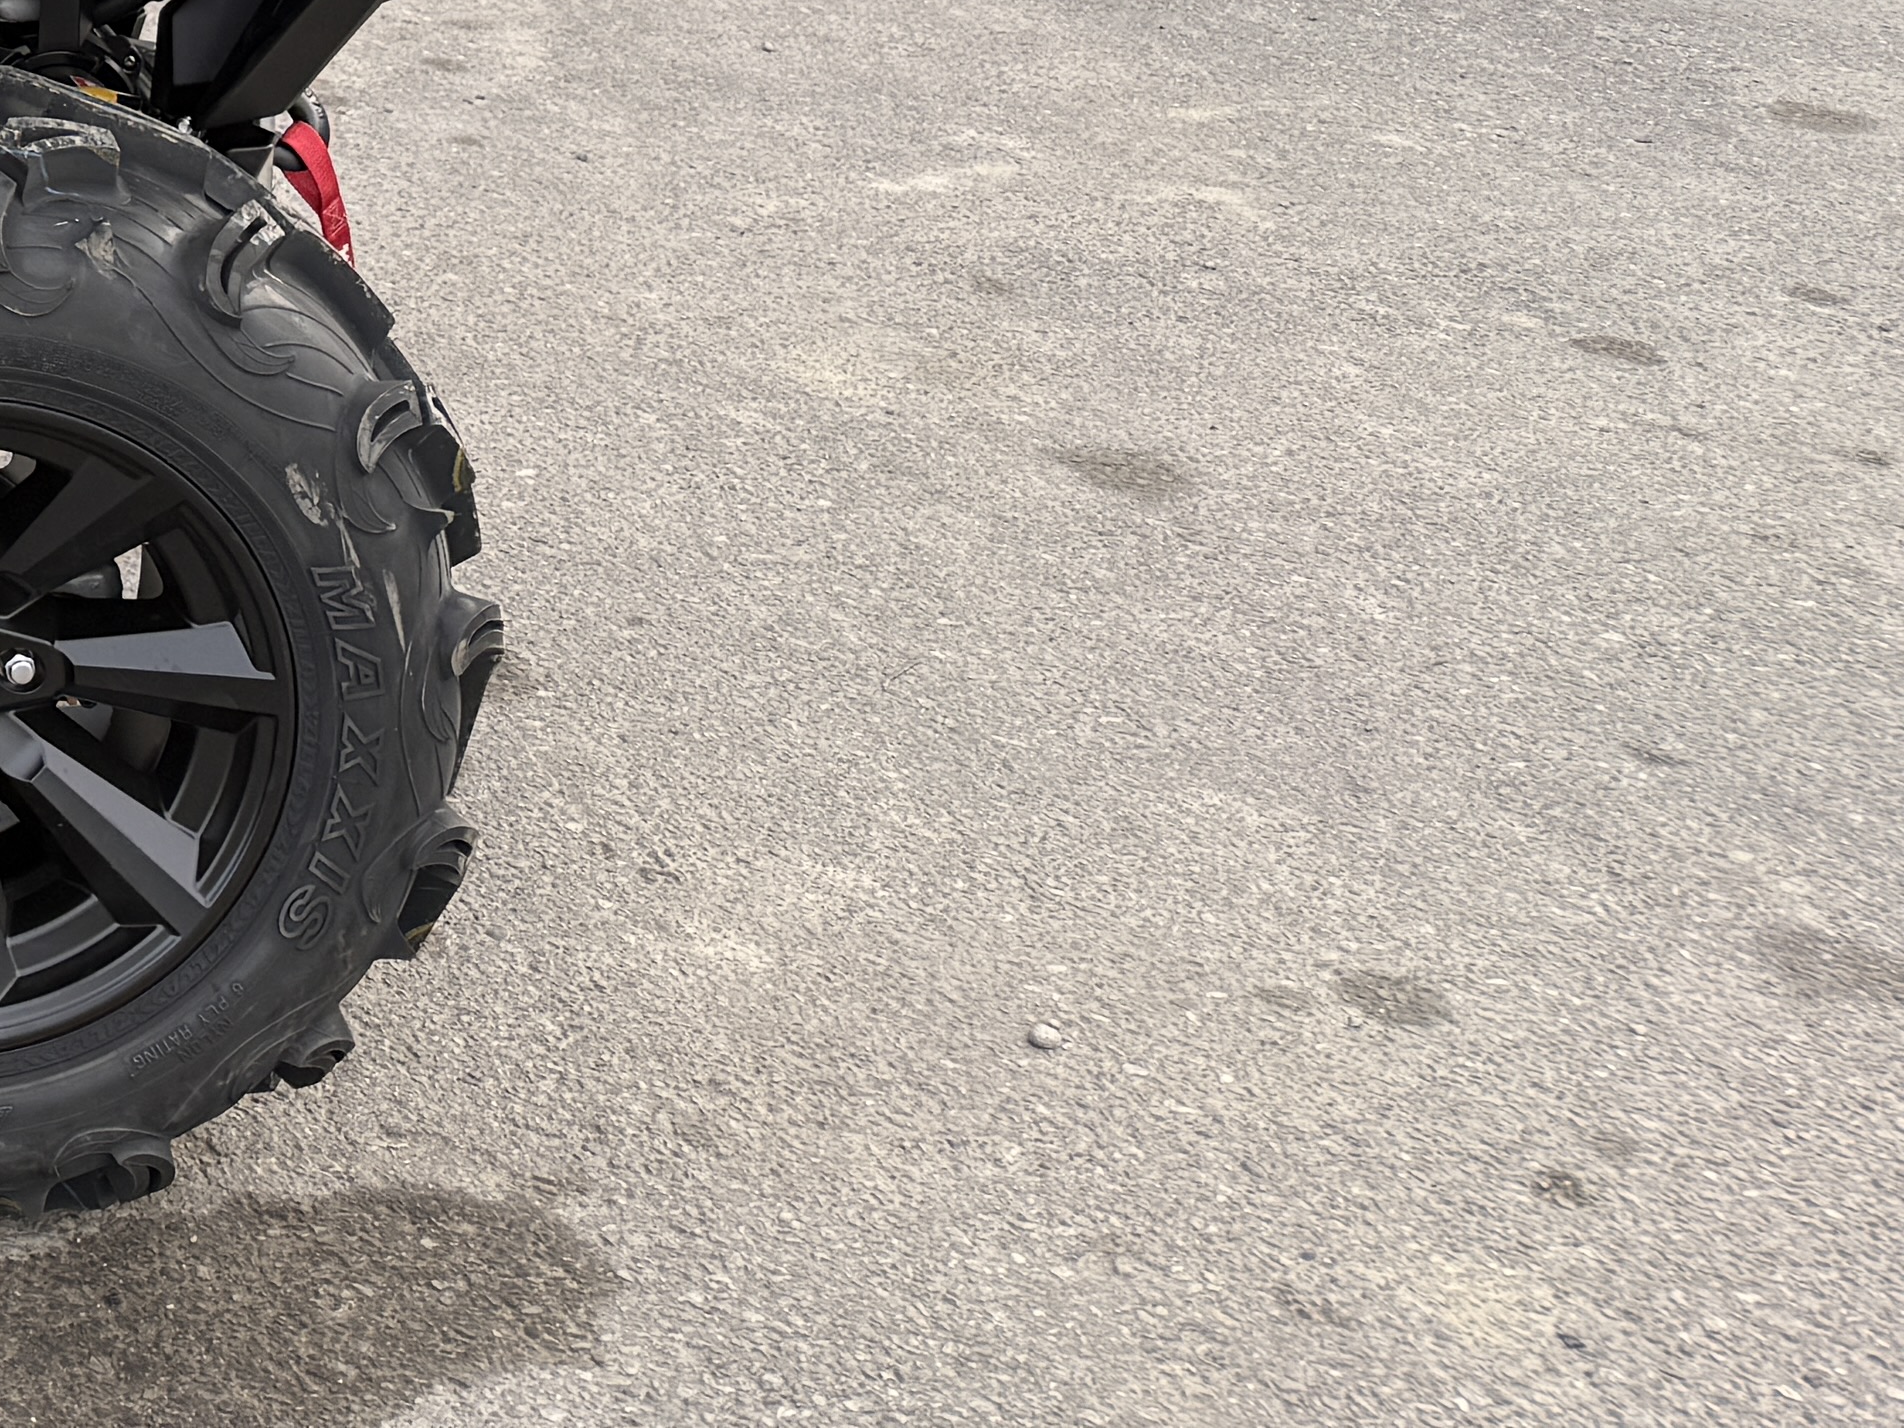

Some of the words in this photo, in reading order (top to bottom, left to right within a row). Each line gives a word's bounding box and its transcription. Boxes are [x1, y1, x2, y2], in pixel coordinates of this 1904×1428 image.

[276, 561, 382, 951] MAXXIS
[200, 992, 235, 1025] PLY
[136, 1021, 194, 1074] RATING
